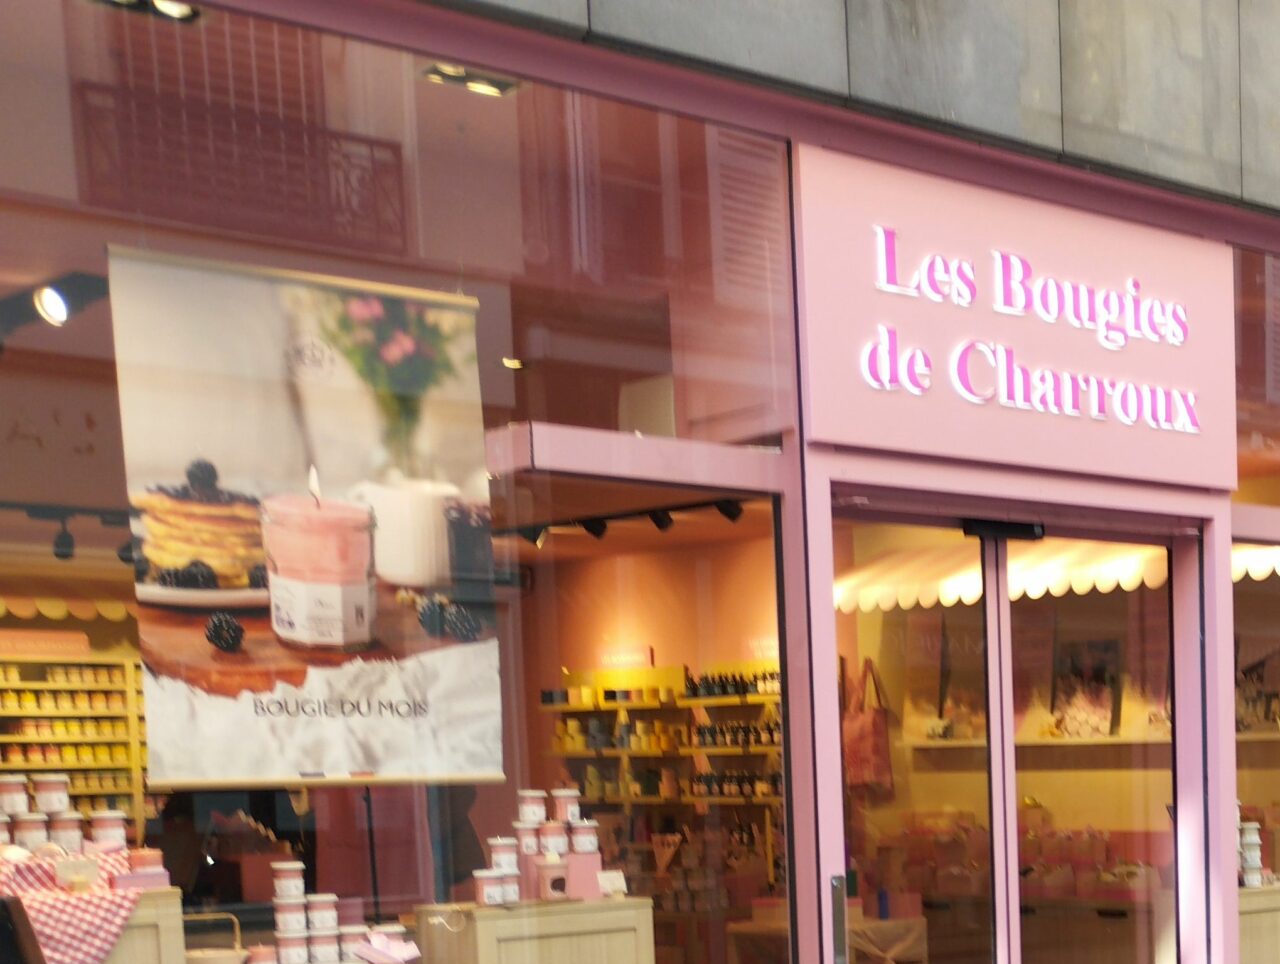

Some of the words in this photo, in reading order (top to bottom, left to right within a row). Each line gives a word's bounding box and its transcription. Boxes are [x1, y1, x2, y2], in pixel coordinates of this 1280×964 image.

[873, 224, 977, 308] Les
[991, 248, 1189, 351] Bougies
[860, 324, 932, 396] de
[949, 340, 1200, 434] Charroux
[253, 698, 334, 718] BOUGIE
[340, 698, 372, 717] DU
[377, 699, 428, 718] MOIS
